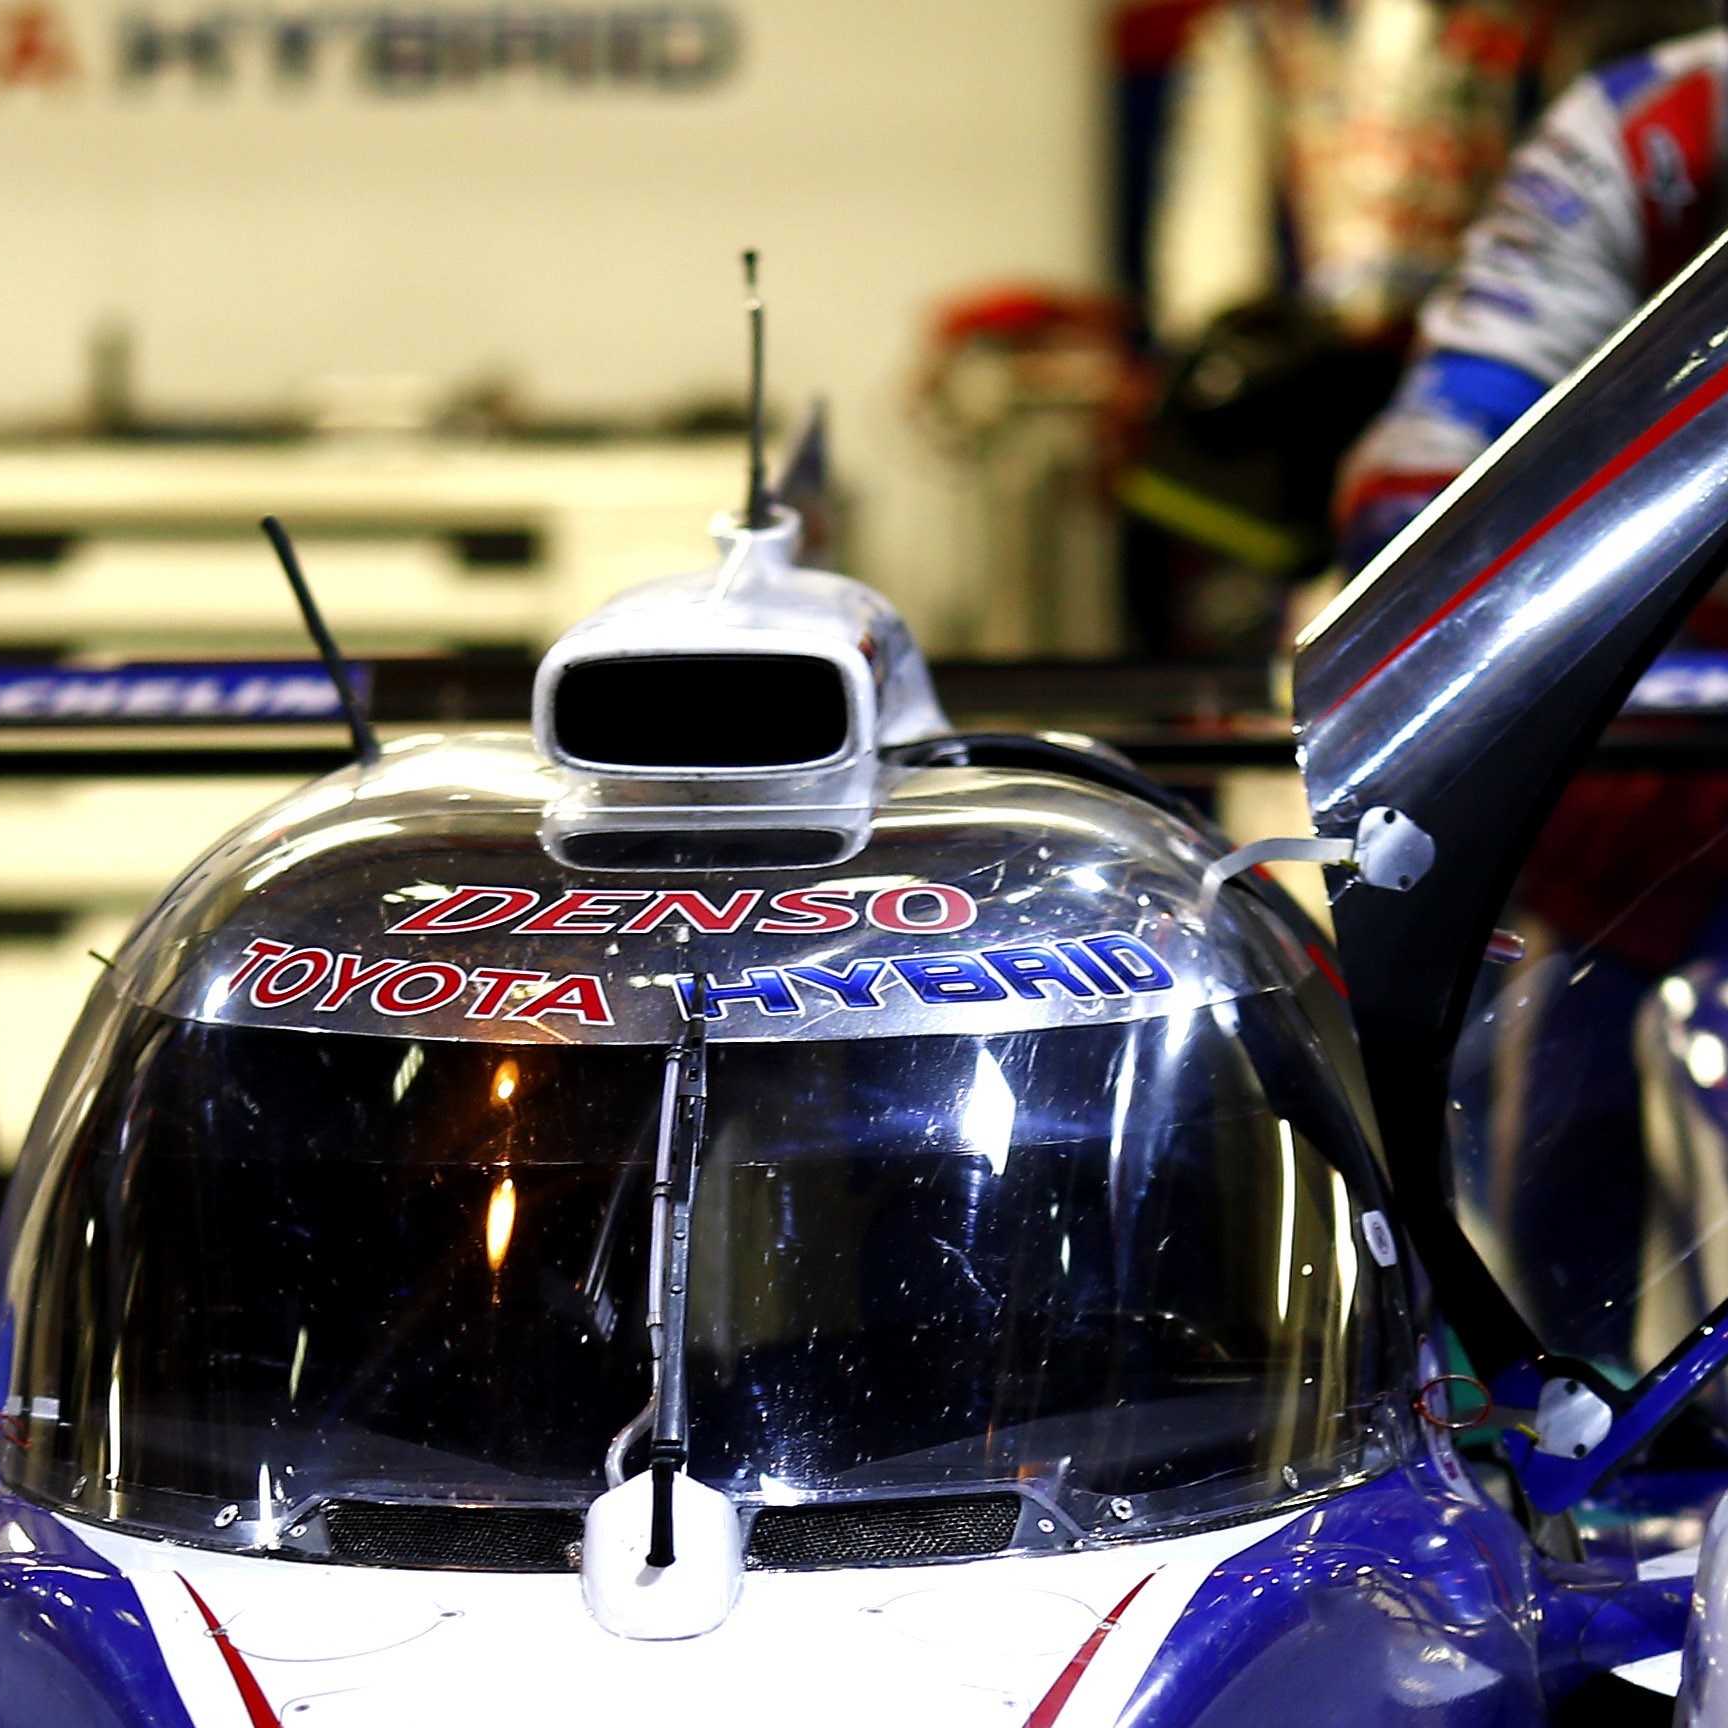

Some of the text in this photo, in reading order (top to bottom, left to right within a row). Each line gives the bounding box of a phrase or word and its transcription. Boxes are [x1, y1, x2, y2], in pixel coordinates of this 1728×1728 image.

[381, 884, 978, 936] DENSO
[228, 930, 1175, 1027] TOYOTA HYBRID
